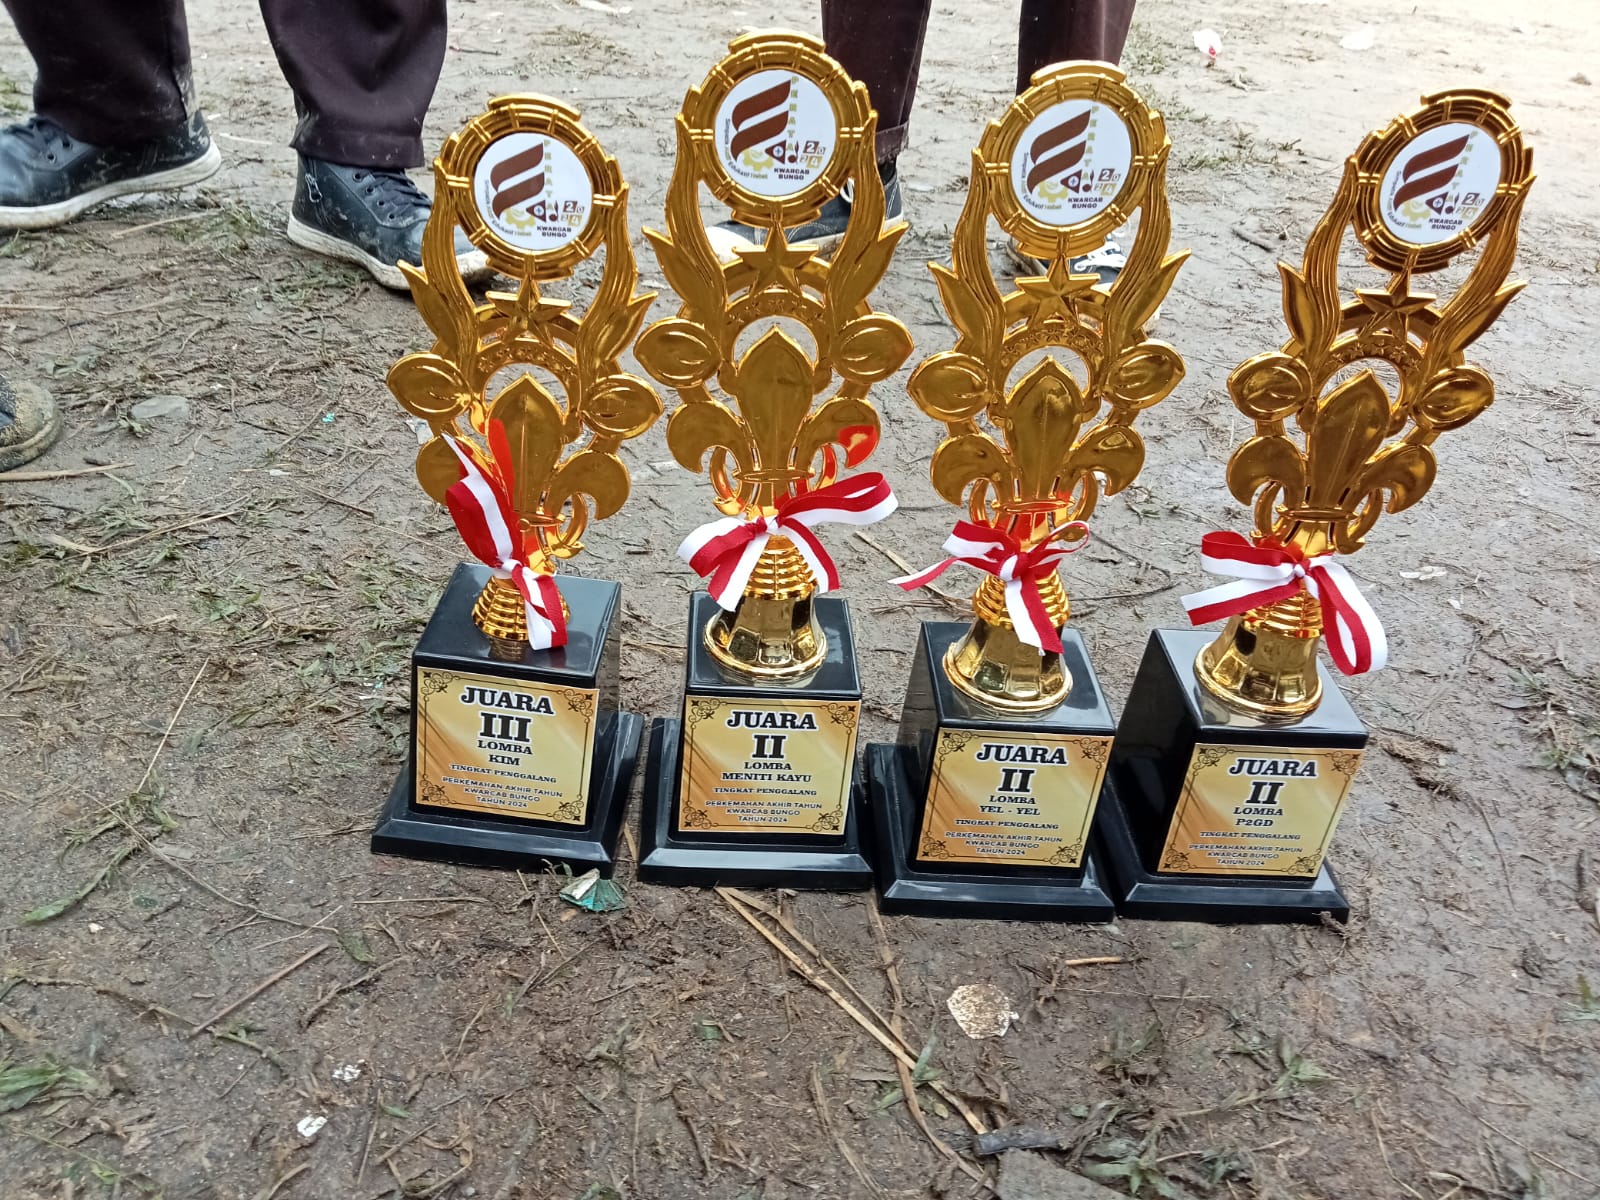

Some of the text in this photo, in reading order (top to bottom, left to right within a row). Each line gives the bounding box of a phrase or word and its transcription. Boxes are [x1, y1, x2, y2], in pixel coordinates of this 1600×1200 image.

[461, 687, 553, 714] JUARA
[727, 711, 817, 730] JUARA
[480, 713, 531, 742] III
[477, 740, 533, 755] LOMBA
[752, 734, 786, 758] II
[489, 754, 520, 766] KIM
[976, 744, 1068, 765] JUARA
[744, 762, 792, 770] LOMBA
[1229, 759, 1318, 777] JUARA
[451, 764, 556, 783] TINGKAT PENGGALANG
[722, 772, 812, 782] MENITI KAYU
[998, 768, 1034, 792] II
[442, 777, 562, 798] PERKEMAHAN AKHIR TAHUN
[756, 788, 817, 796] PENGGALANG
[1246, 782, 1284, 805] II
[464, 788, 540, 802] KWARCAB BUNGO
[990, 795, 1036, 804] LOMBA
[477, 796, 528, 808] TAHUN 2024
[980, 806, 1004, 814] YEL
[1016, 807, 1040, 816] YEL
[1233, 807, 1284, 816] LOMBA
[998, 822, 1059, 830] PENGGALANG
[1236, 818, 1274, 827] P2GD
[1240, 832, 1301, 840] PENGGALANG
[966, 840, 1008, 848] KWARCAB
